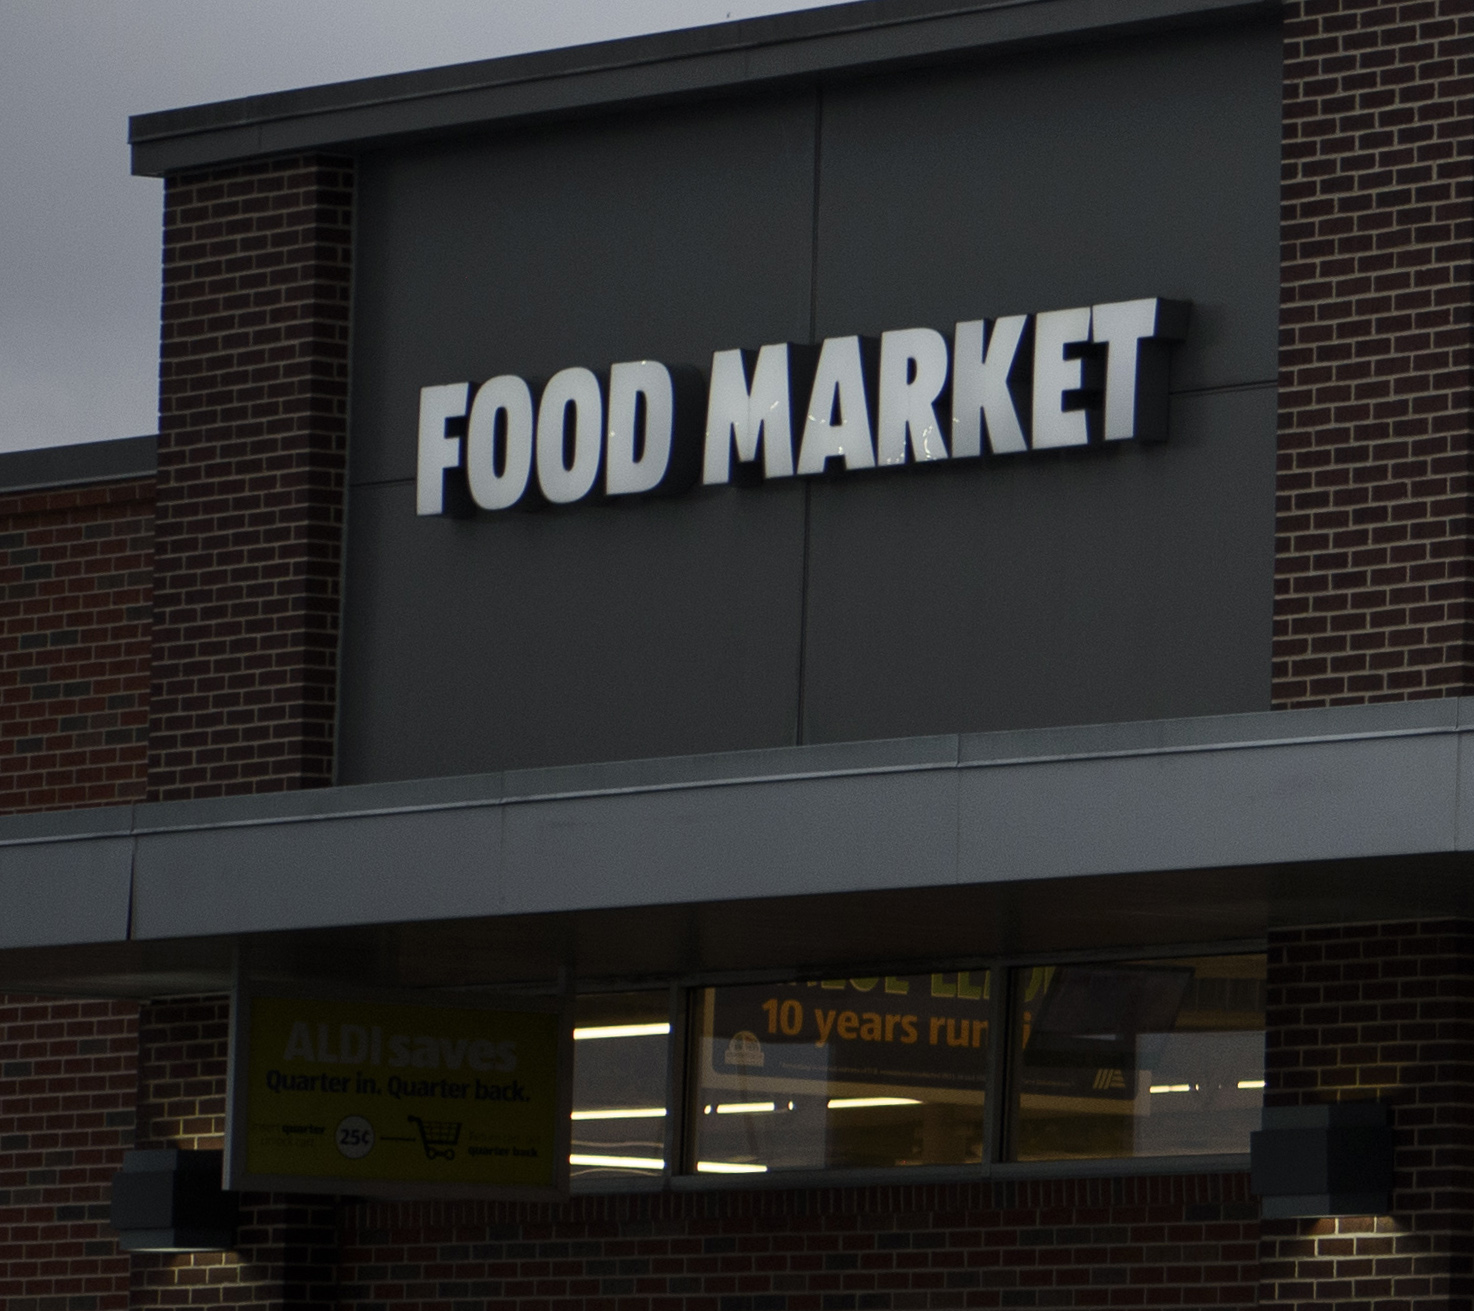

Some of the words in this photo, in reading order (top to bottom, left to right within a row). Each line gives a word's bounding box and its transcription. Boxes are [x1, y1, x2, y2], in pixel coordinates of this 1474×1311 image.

[416, 359, 674, 517] FOOD
[702, 297, 1161, 486] MARKET
[283, 1020, 383, 1067] ALDI
[388, 1035, 520, 1073] saves
[761, 997, 803, 1036] 10
[814, 1007, 919, 1048] years
[266, 1070, 349, 1093] Quarter
[356, 1071, 382, 1096] in.
[388, 1076, 467, 1100] Quarter
[474, 1079, 531, 1102] back.
[340, 1129, 370, 1145] 25¢
